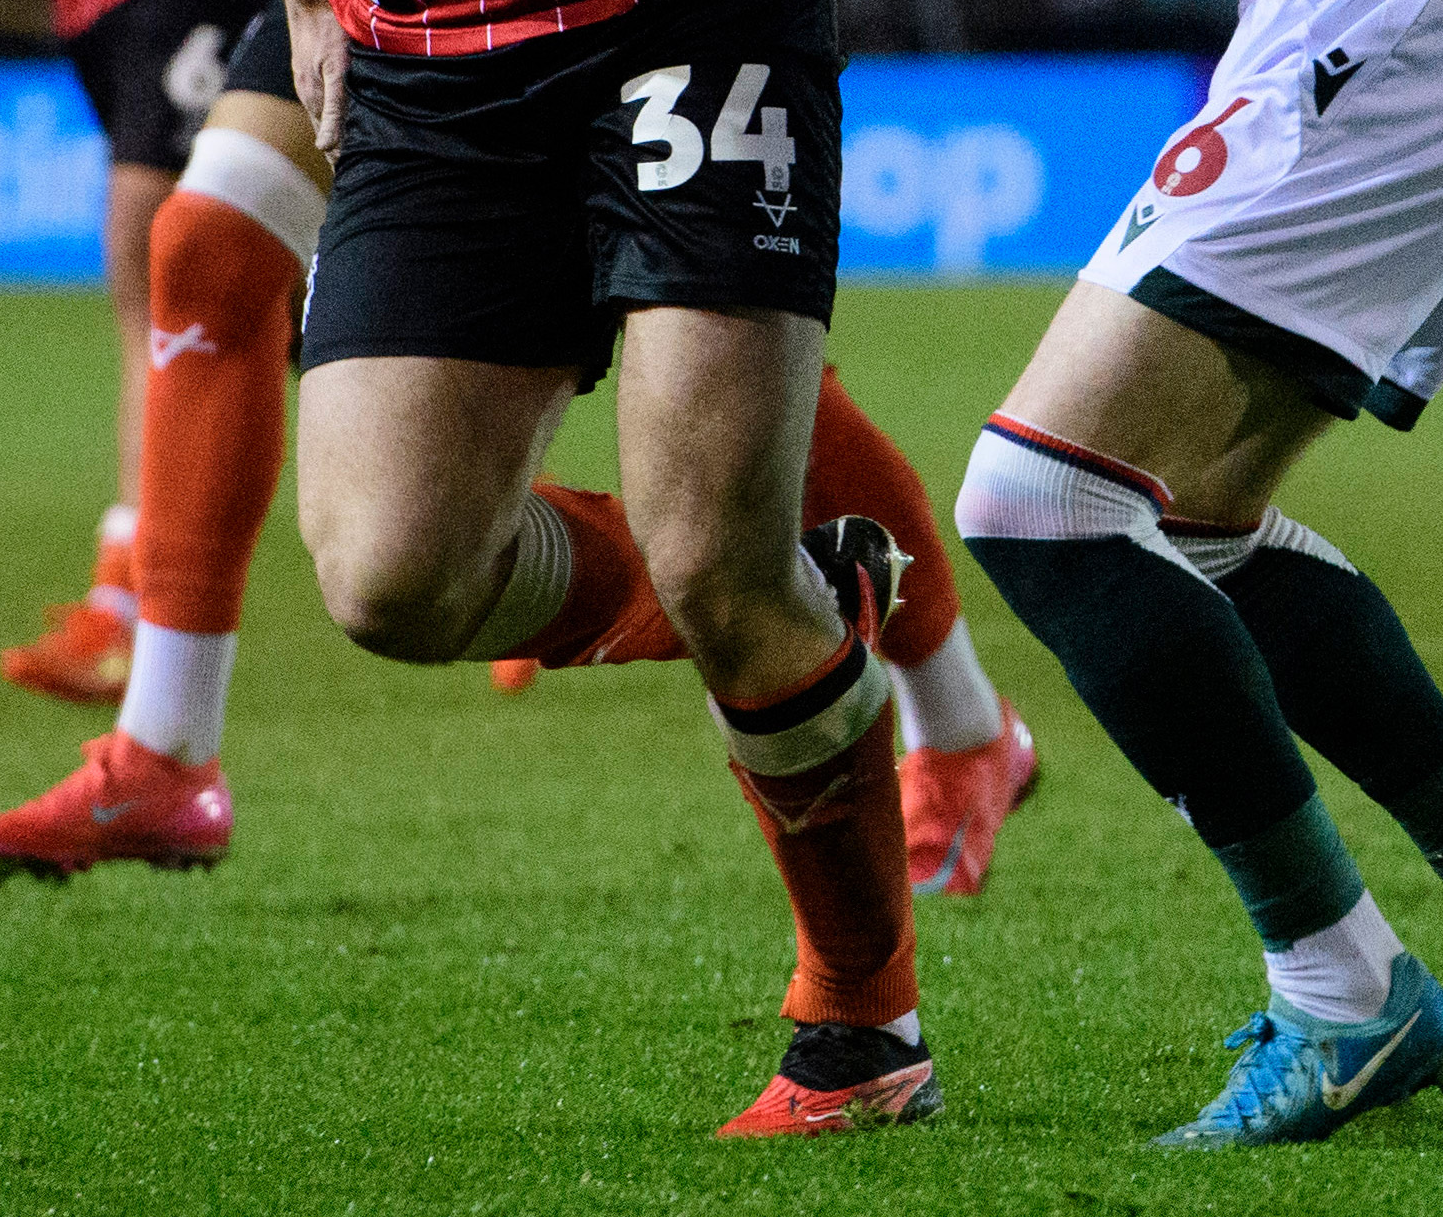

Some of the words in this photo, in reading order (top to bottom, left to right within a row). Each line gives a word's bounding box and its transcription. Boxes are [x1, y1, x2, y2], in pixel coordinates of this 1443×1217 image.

[620, 63, 797, 192] 34
[1152, 96, 1255, 198] 6
[752, 234, 800, 255] OXEN
